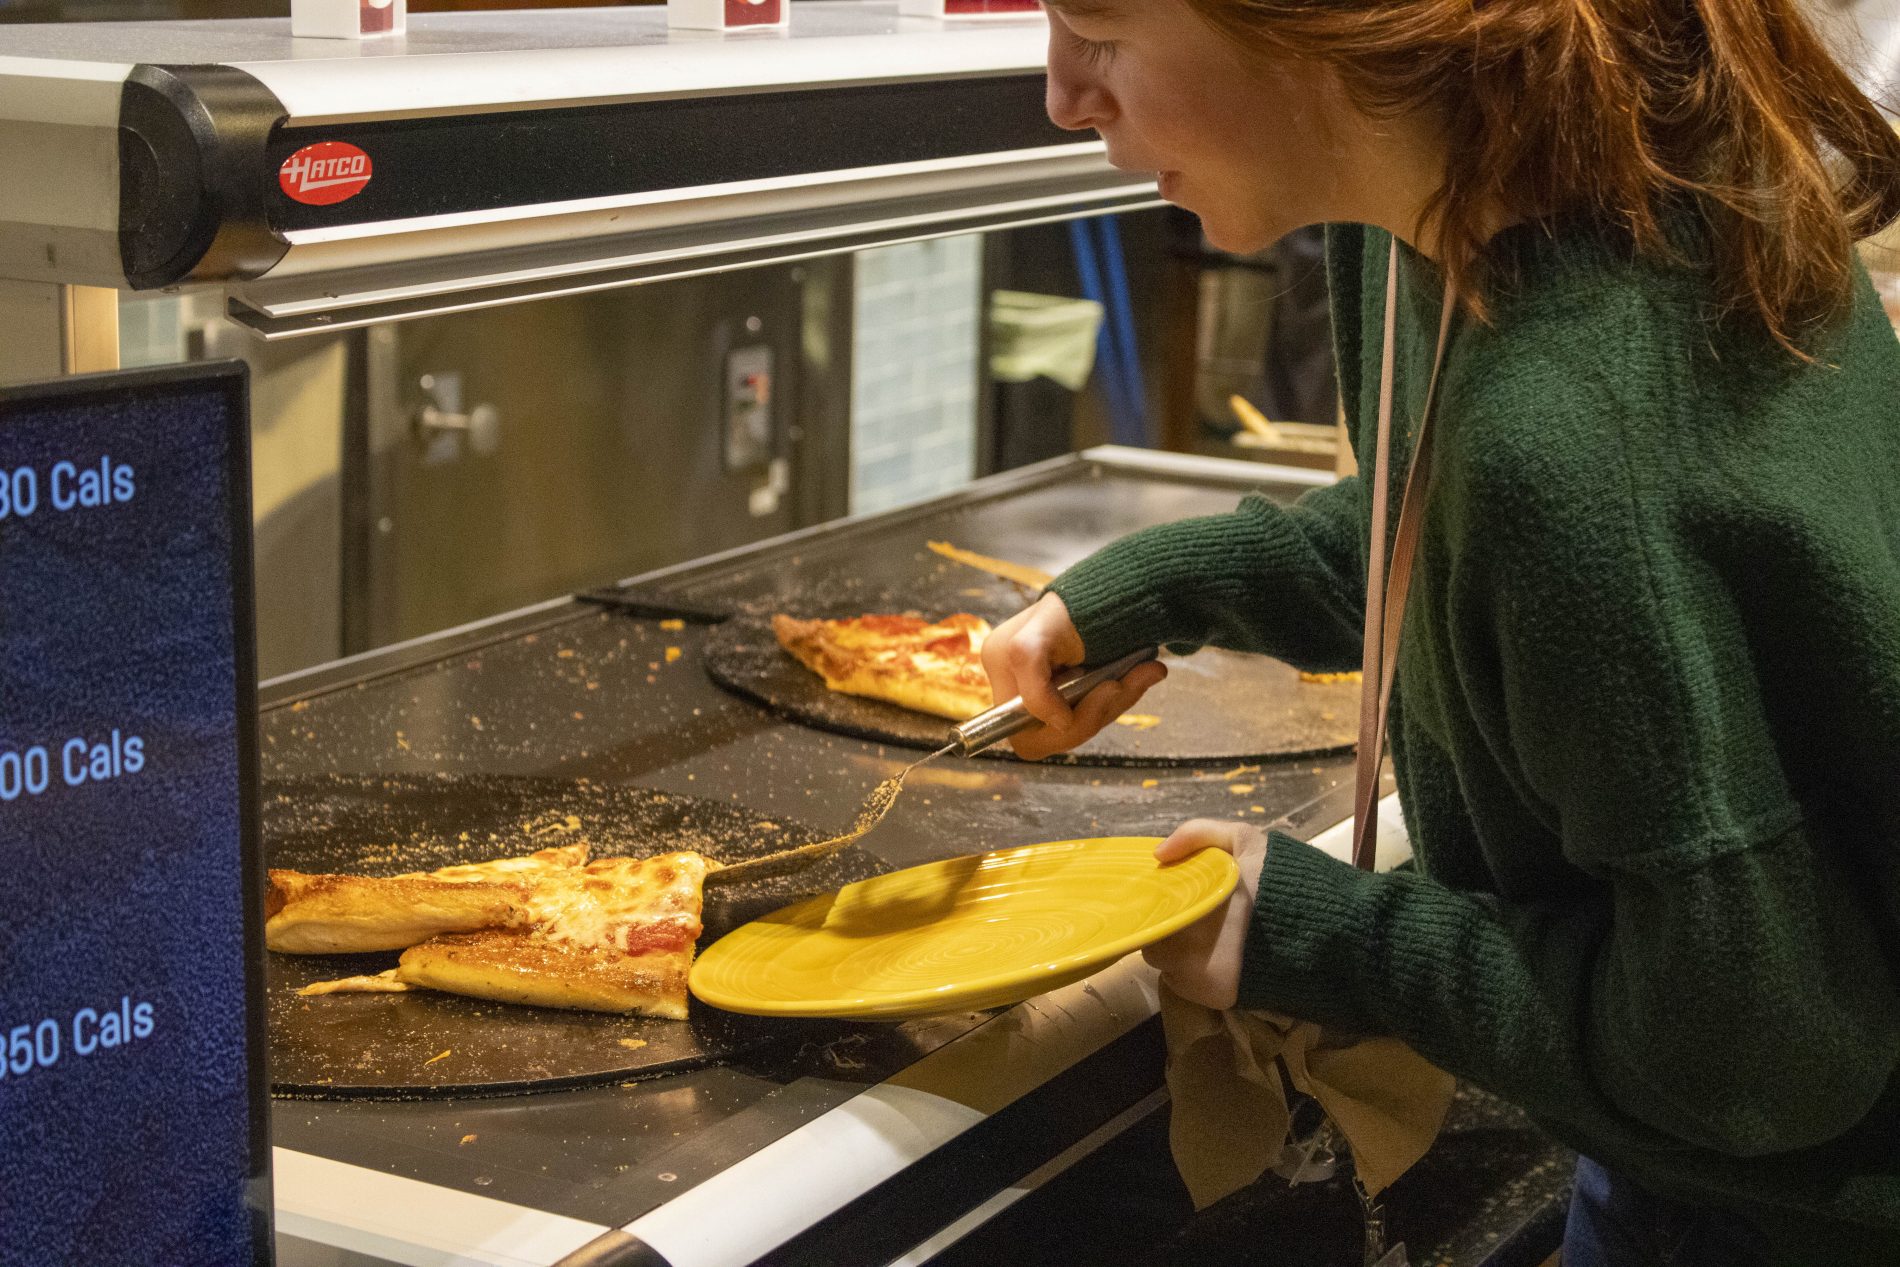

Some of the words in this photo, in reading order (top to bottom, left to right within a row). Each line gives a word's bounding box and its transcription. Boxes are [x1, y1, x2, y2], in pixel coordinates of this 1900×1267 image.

[281, 154, 371, 192] HATCO
[51, 455, 135, 511] Cals
[0, 745, 48, 799] 00
[63, 728, 145, 786] Cals
[73, 996, 154, 1055] Cals
